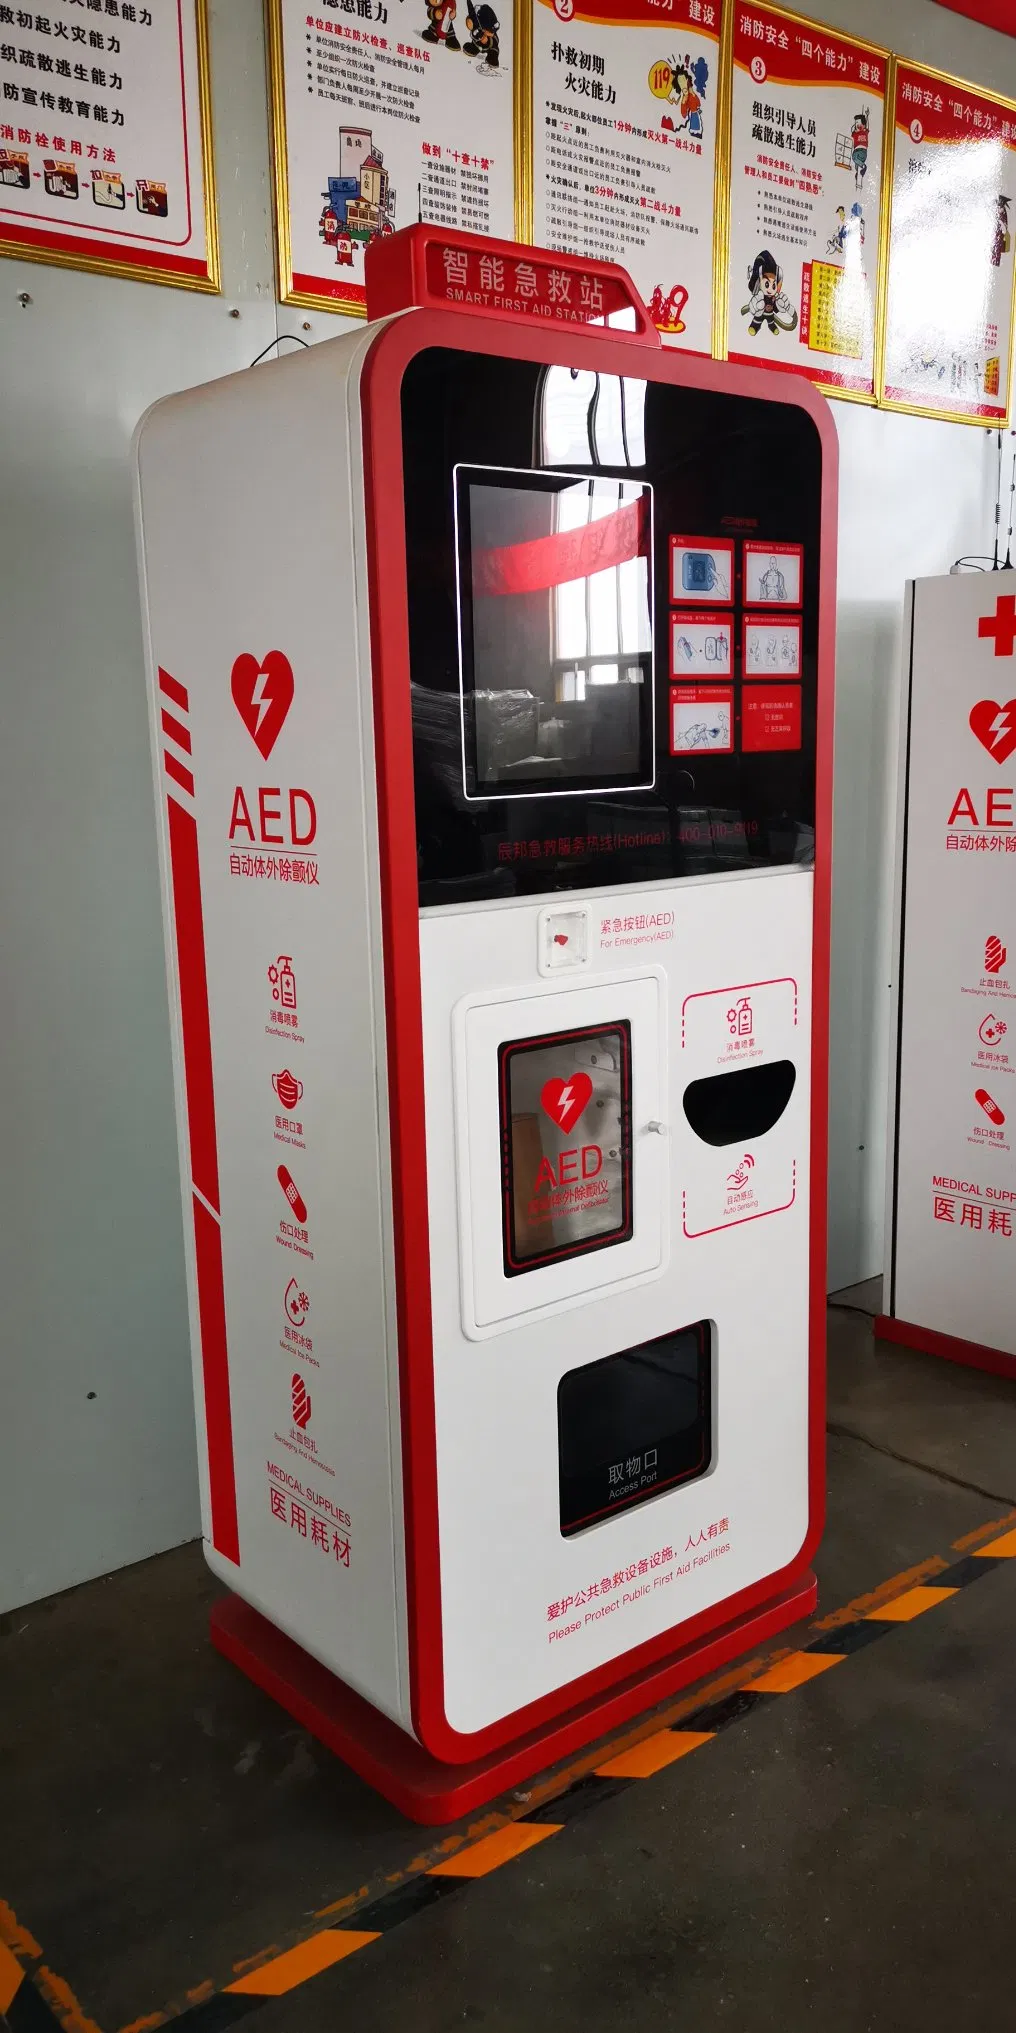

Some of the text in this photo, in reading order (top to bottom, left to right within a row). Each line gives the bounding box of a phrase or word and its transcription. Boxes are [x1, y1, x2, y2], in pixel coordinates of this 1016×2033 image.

[551, 41, 605, 76] 扑救初期
[564, 72, 617, 105] 火灾能力
[654, 68, 670, 89] 119
[752, 100, 817, 138] 组织引导人员
[0, 123, 116, 163] 消防栓使用方法
[752, 123, 817, 158] 疏散逃生能力
[443, 247, 604, 311] 智能急救站
[446, 288, 604, 323] SMART FIRST AID STATIO
[228, 786, 317, 846] AED
[229, 852, 319, 885] 自动体外除颤仪
[600, 911, 675, 935] 紧急按钮(AED)
[600, 939, 613, 949] For
[979, 978, 1011, 989] 止血包扎
[977, 1050, 1009, 1064] 医用冰袋
[275, 1115, 303, 1135] 医用口罩
[973, 1126, 1005, 1141] 伤口处理
[534, 1144, 603, 1193] AED
[932, 1175, 983, 1196] MEDICAL
[280, 1220, 309, 1244] 伤口处理
[934, 1196, 1012, 1237] 医用耗
[284, 1326, 313, 1351] 医用冰袋
[608, 1448, 658, 1485] 取物口
[266, 1460, 352, 1527] MEDICAL SUPPLIES
[608, 1471, 658, 1500] Access Port
[270, 1486, 352, 1568] 医用耗材
[548, 1543, 731, 1644] Please Protect Public First Aid Facilities
